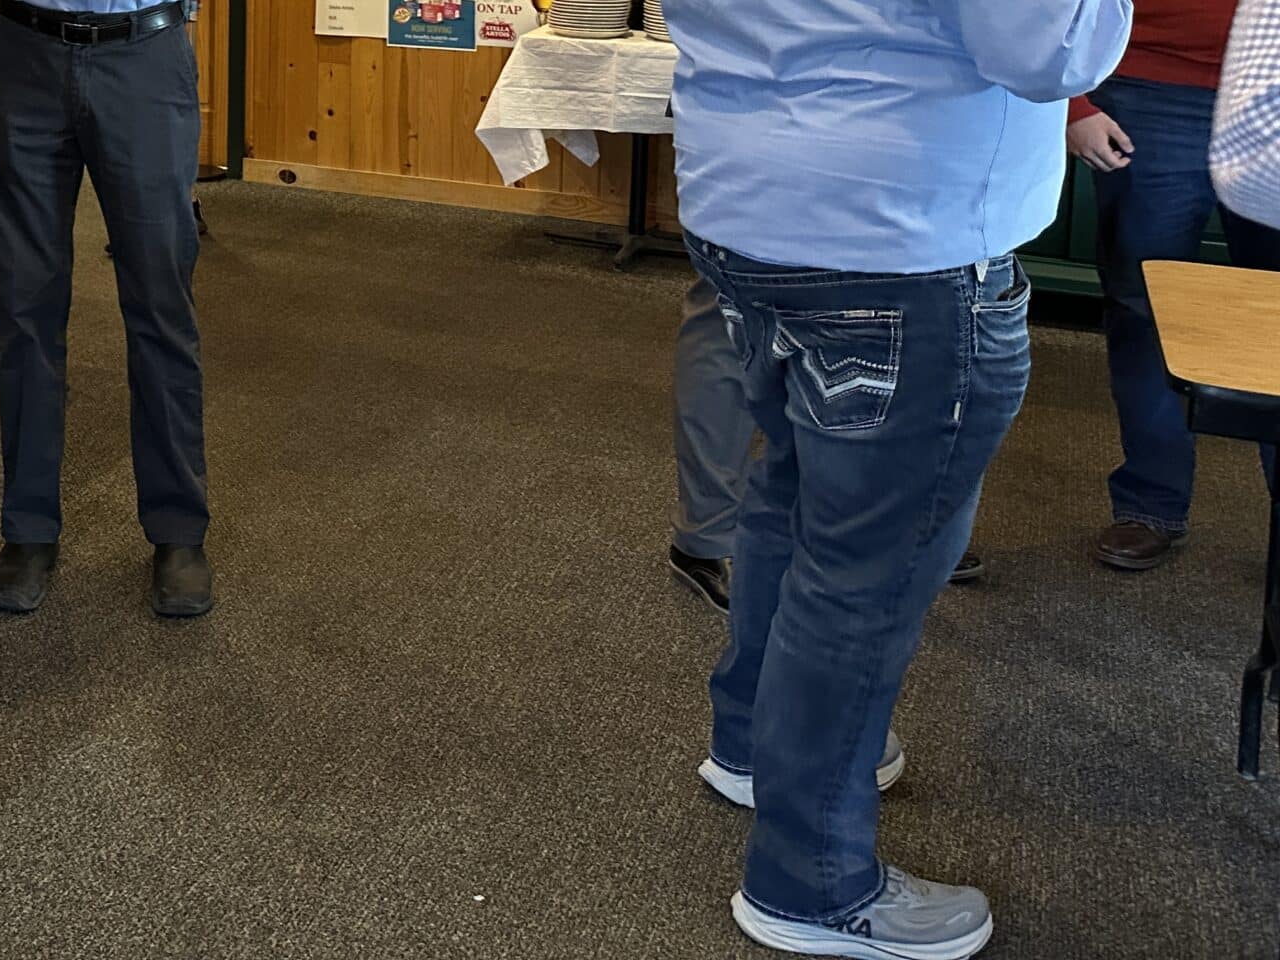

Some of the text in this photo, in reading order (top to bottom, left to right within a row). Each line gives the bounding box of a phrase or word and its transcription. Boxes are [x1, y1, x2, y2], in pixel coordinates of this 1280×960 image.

[477, 3, 523, 15] ON TAP
[485, 24, 510, 32] STELLA
